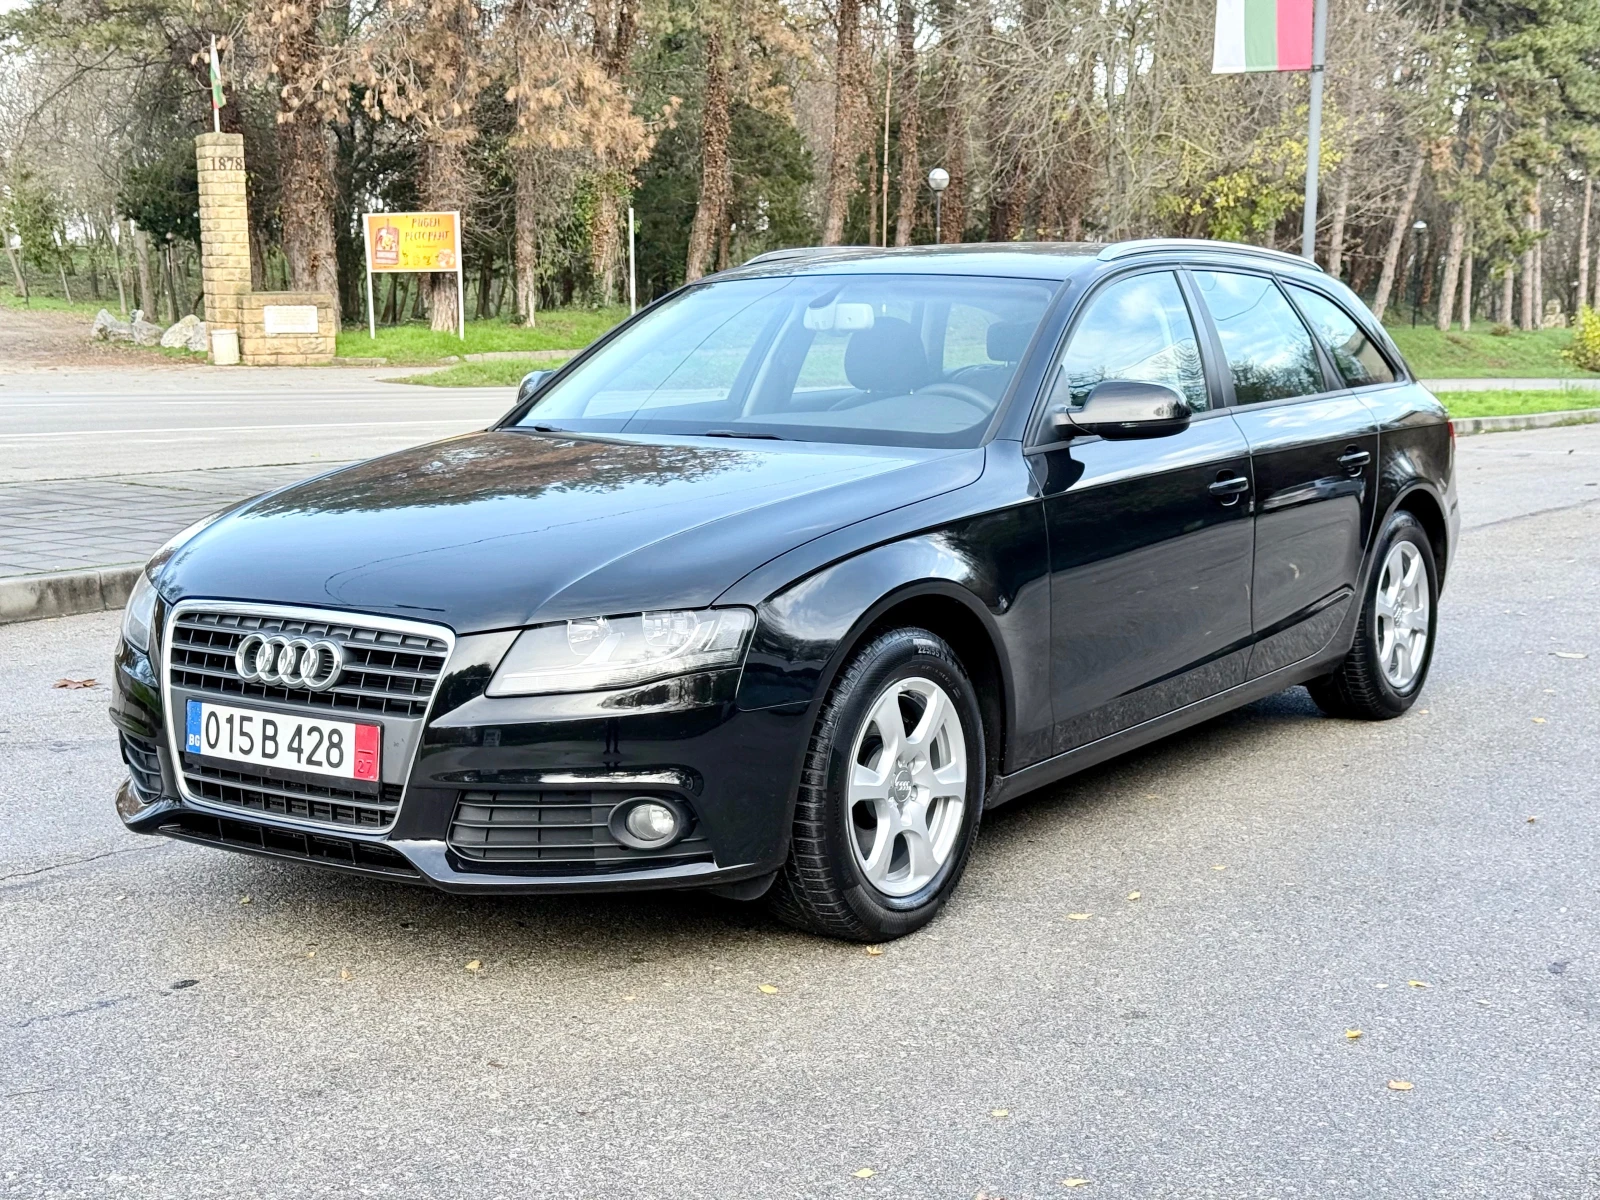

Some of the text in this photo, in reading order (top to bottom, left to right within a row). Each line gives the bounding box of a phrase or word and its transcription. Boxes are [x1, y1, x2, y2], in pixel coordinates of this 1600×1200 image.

[210, 157, 243, 170] 1878
[189, 733, 200, 747] BG
[357, 759, 373, 774] 27
